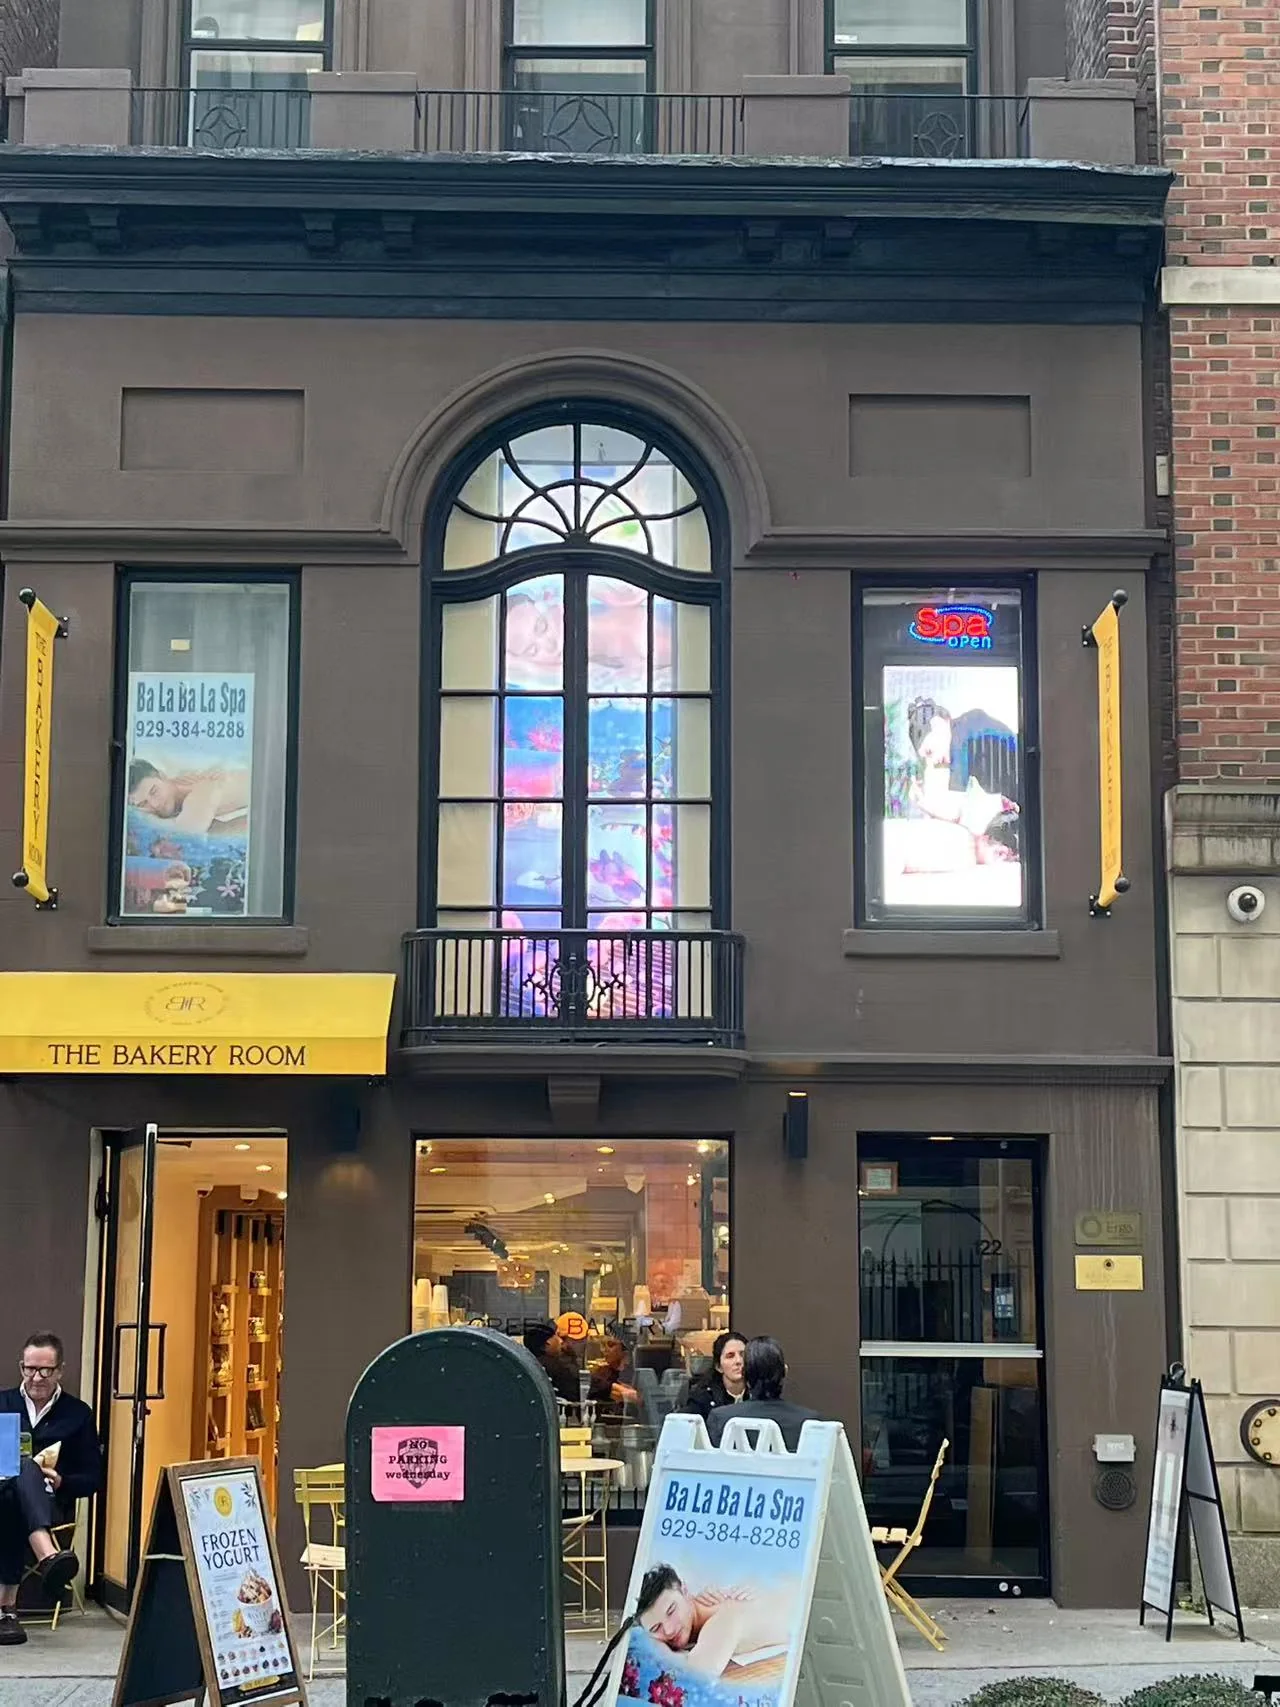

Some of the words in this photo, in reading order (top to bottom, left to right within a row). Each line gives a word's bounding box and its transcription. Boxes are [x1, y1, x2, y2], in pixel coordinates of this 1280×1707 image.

[917, 607, 988, 638] Spa
[137, 682, 154, 712] Ba
[159, 682, 174, 712] La
[179, 682, 195, 712] Ba
[200, 682, 216, 712] La
[220, 682, 246, 717] Spa
[136, 720, 245, 738] 929-384-8288
[48, 1044, 101, 1065] THE
[113, 1044, 217, 1065] BAKERY
[228, 1045, 306, 1066] ROOM
[981, 1239, 1003, 1255] 22
[410, 1440, 427, 1449] NO
[388, 1455, 448, 1464] PARKING
[385, 1469, 451, 1481] wednesday
[665, 1480, 689, 1512] Ba
[691, 1482, 713, 1514] La
[716, 1484, 740, 1516] Ba
[744, 1486, 766, 1519] La
[770, 1488, 805, 1525] Spa
[201, 1528, 257, 1553] FROZEN
[660, 1517, 802, 1549] 929-384-8288
[203, 1545, 260, 1571] YOGURT
